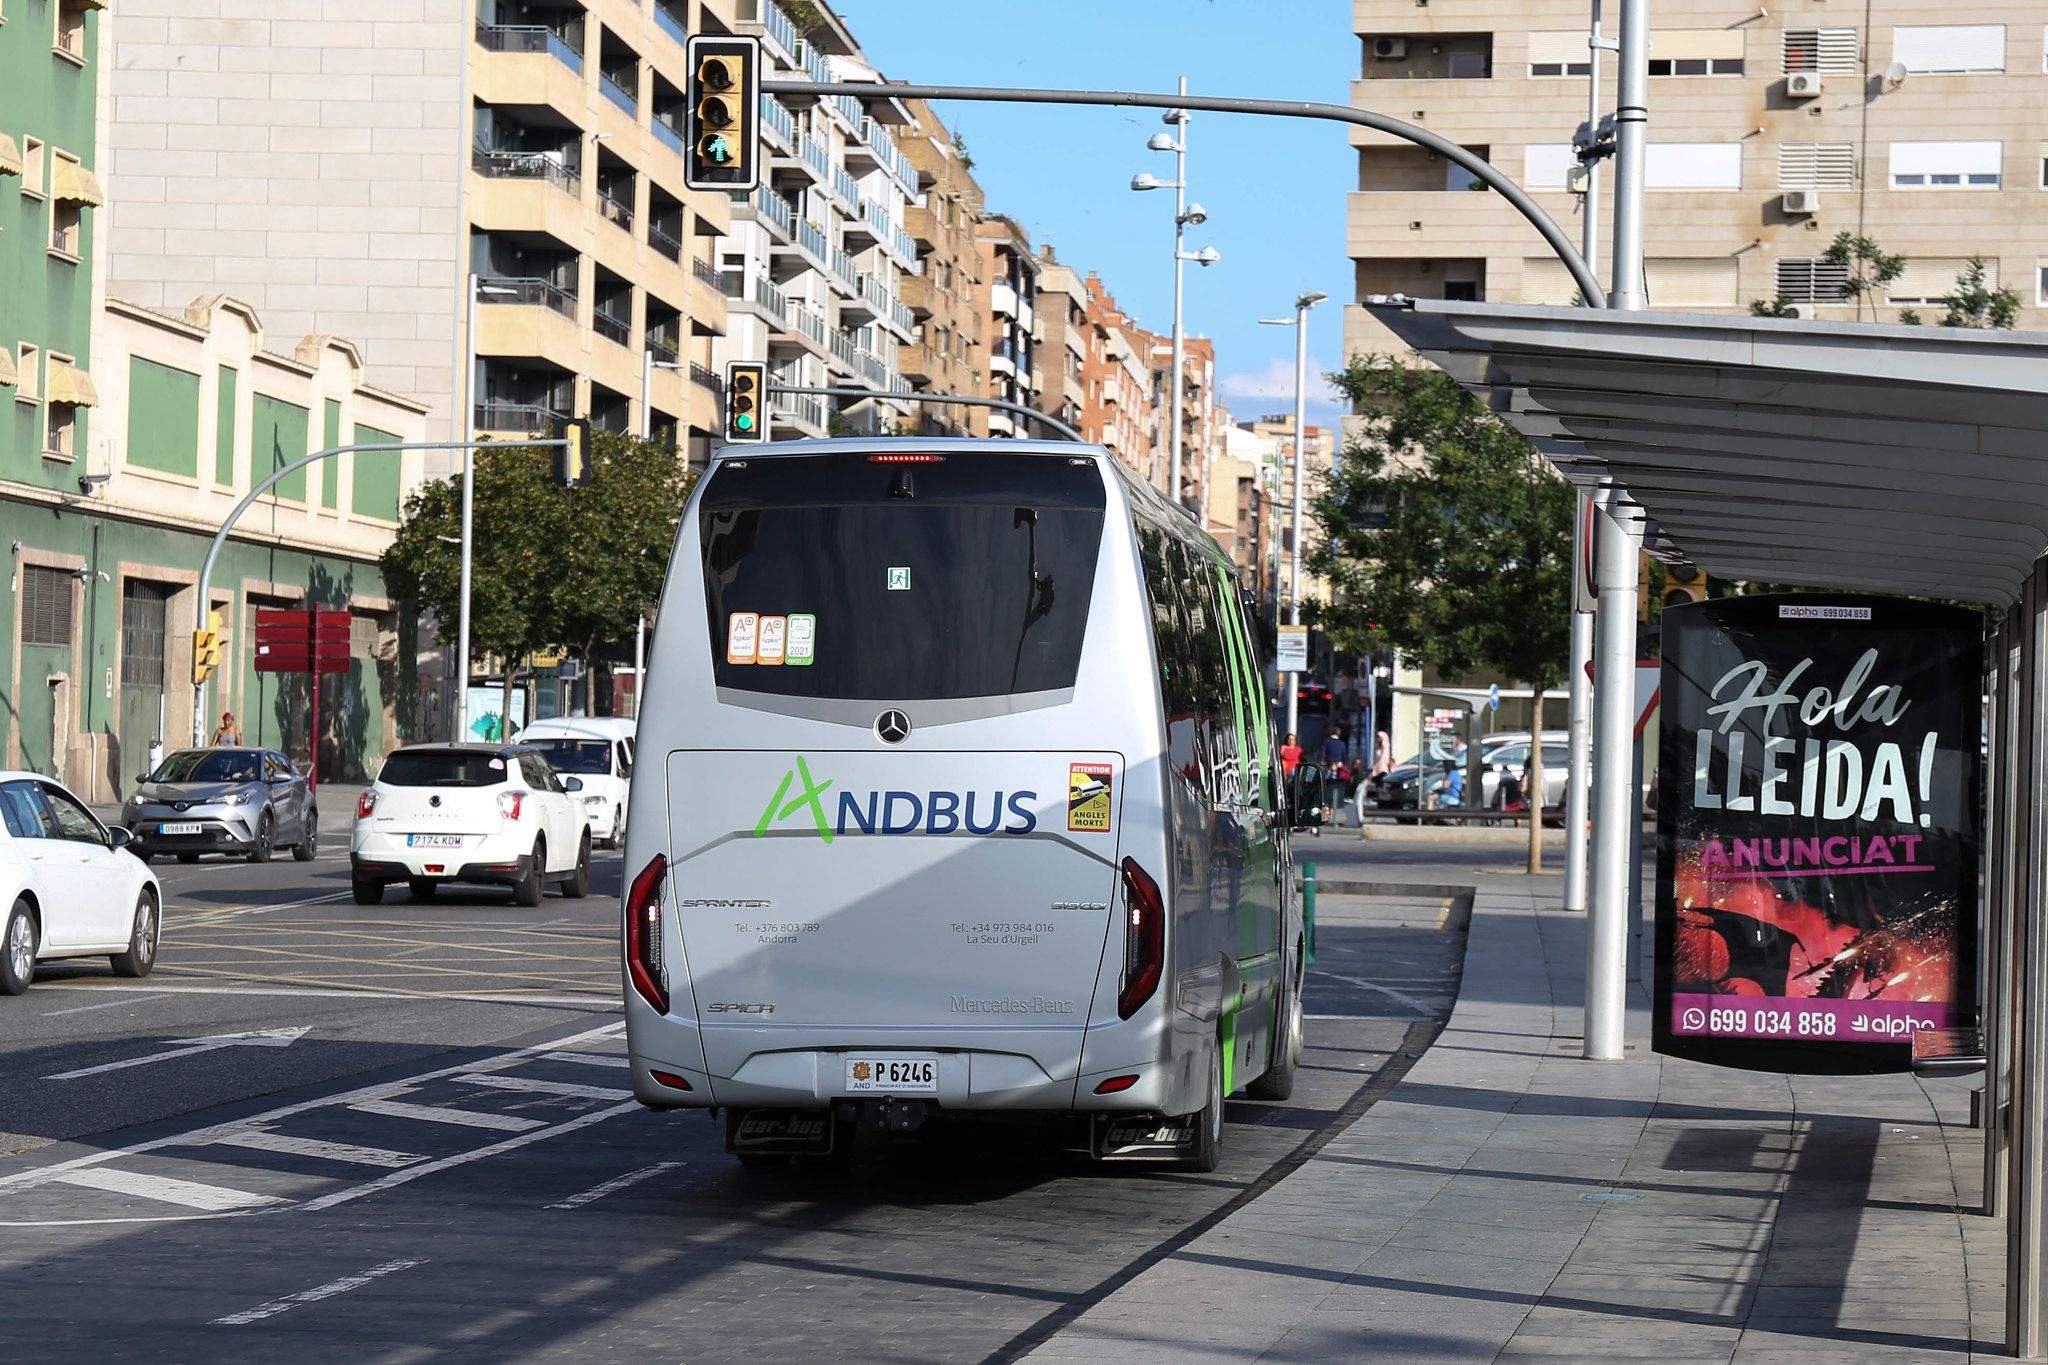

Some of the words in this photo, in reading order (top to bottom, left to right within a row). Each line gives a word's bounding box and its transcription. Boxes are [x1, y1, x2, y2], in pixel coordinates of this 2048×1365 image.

[1823, 608, 1837, 617] 699
[1838, 608, 1852, 617] 034
[1853, 609, 1869, 619] 858
[790, 646, 808, 656] 2021
[1706, 648, 1912, 738] Hola
[1072, 765, 1110, 774] ATTENTION
[1694, 729, 1939, 829] LLEIDA!
[752, 755, 1038, 844] ANDBUS
[1073, 811, 1106, 819] ANGLES
[1074, 819, 1104, 827] MORTS
[414, 834, 439, 845] 7174
[442, 834, 461, 845] KDM
[1700, 834, 1923, 867] ANUNCIA'T
[681, 900, 772, 908] SPRINTER
[755, 923, 778, 933] +376
[780, 923, 800, 933] 803
[802, 923, 820, 933] 789
[971, 923, 990, 933] +34
[993, 923, 1011, 933] 973
[1013, 923, 1032, 933] 984
[1034, 923, 1054, 933] 016
[757, 935, 797, 944] Andorra
[966, 935, 978, 944] La
[981, 935, 999, 944] Seu
[1002, 934, 1039, 946] d'Urgell
[707, 1003, 776, 1014] SPICA
[950, 995, 1073, 1015] Mercedes-Benz
[1709, 1008, 1748, 1033] 699
[1754, 1009, 1792, 1035] 034
[1798, 1011, 1837, 1036] 858
[875, 1062, 885, 1082] P
[890, 1062, 932, 1083] 6246
[853, 1082, 871, 1090] AND
